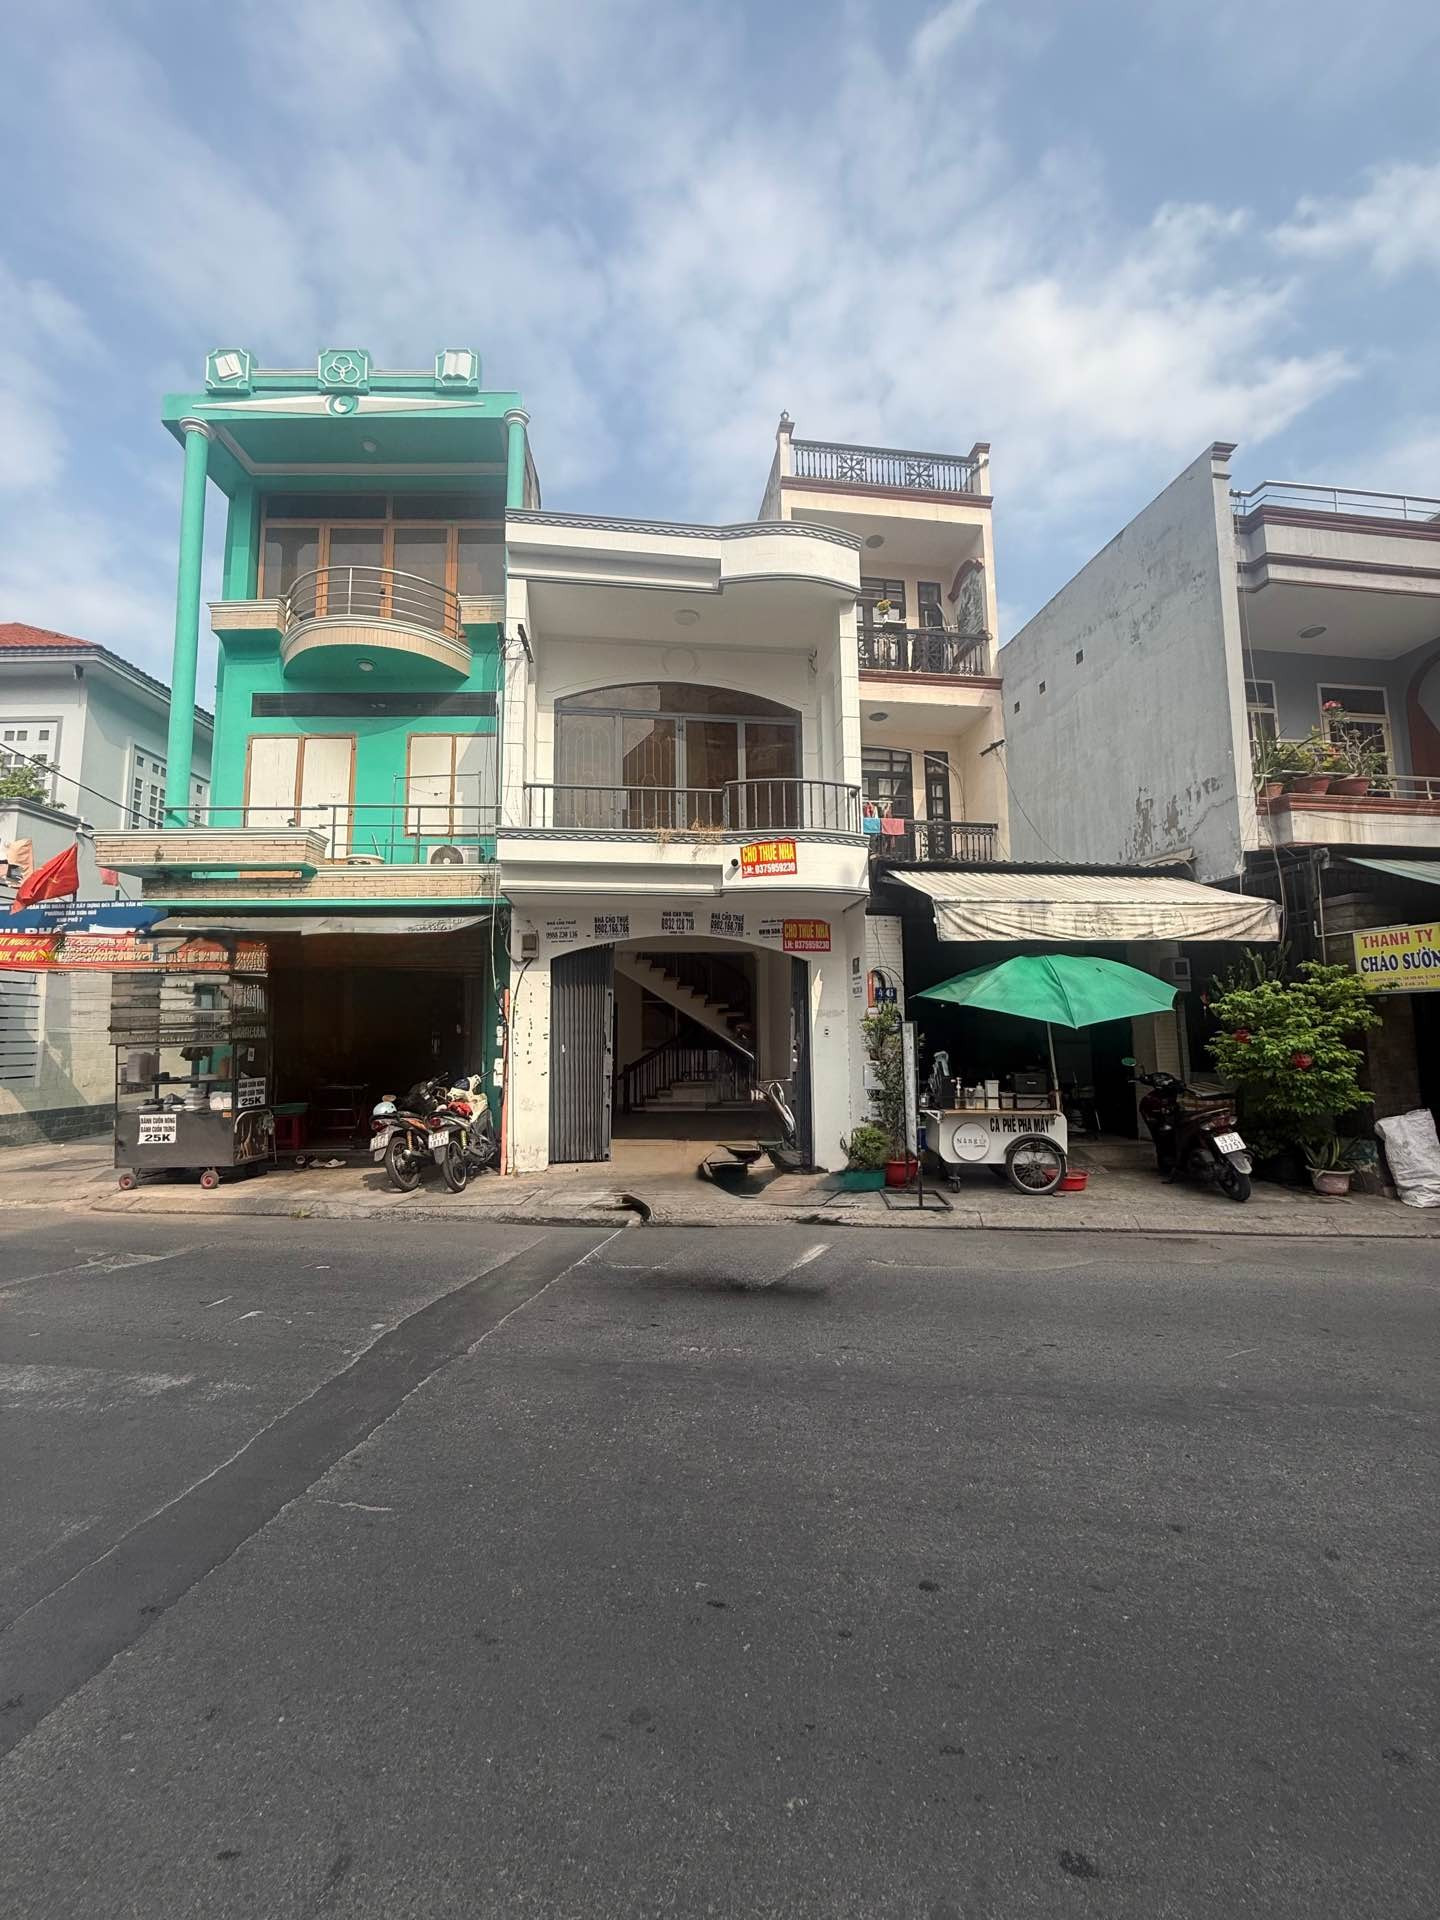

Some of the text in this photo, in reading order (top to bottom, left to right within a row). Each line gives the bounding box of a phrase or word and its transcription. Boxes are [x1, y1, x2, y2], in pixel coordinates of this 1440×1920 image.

[743, 845, 757, 863] CHO
[784, 923, 798, 938] CHO
[1361, 929, 1433, 948] THANH TY
[1361, 950, 1399, 972] CHÁO
[241, 1096, 261, 1106] 25K
[1018, 1117, 1033, 1133] PHA
[144, 1134, 171, 1142] 25K
